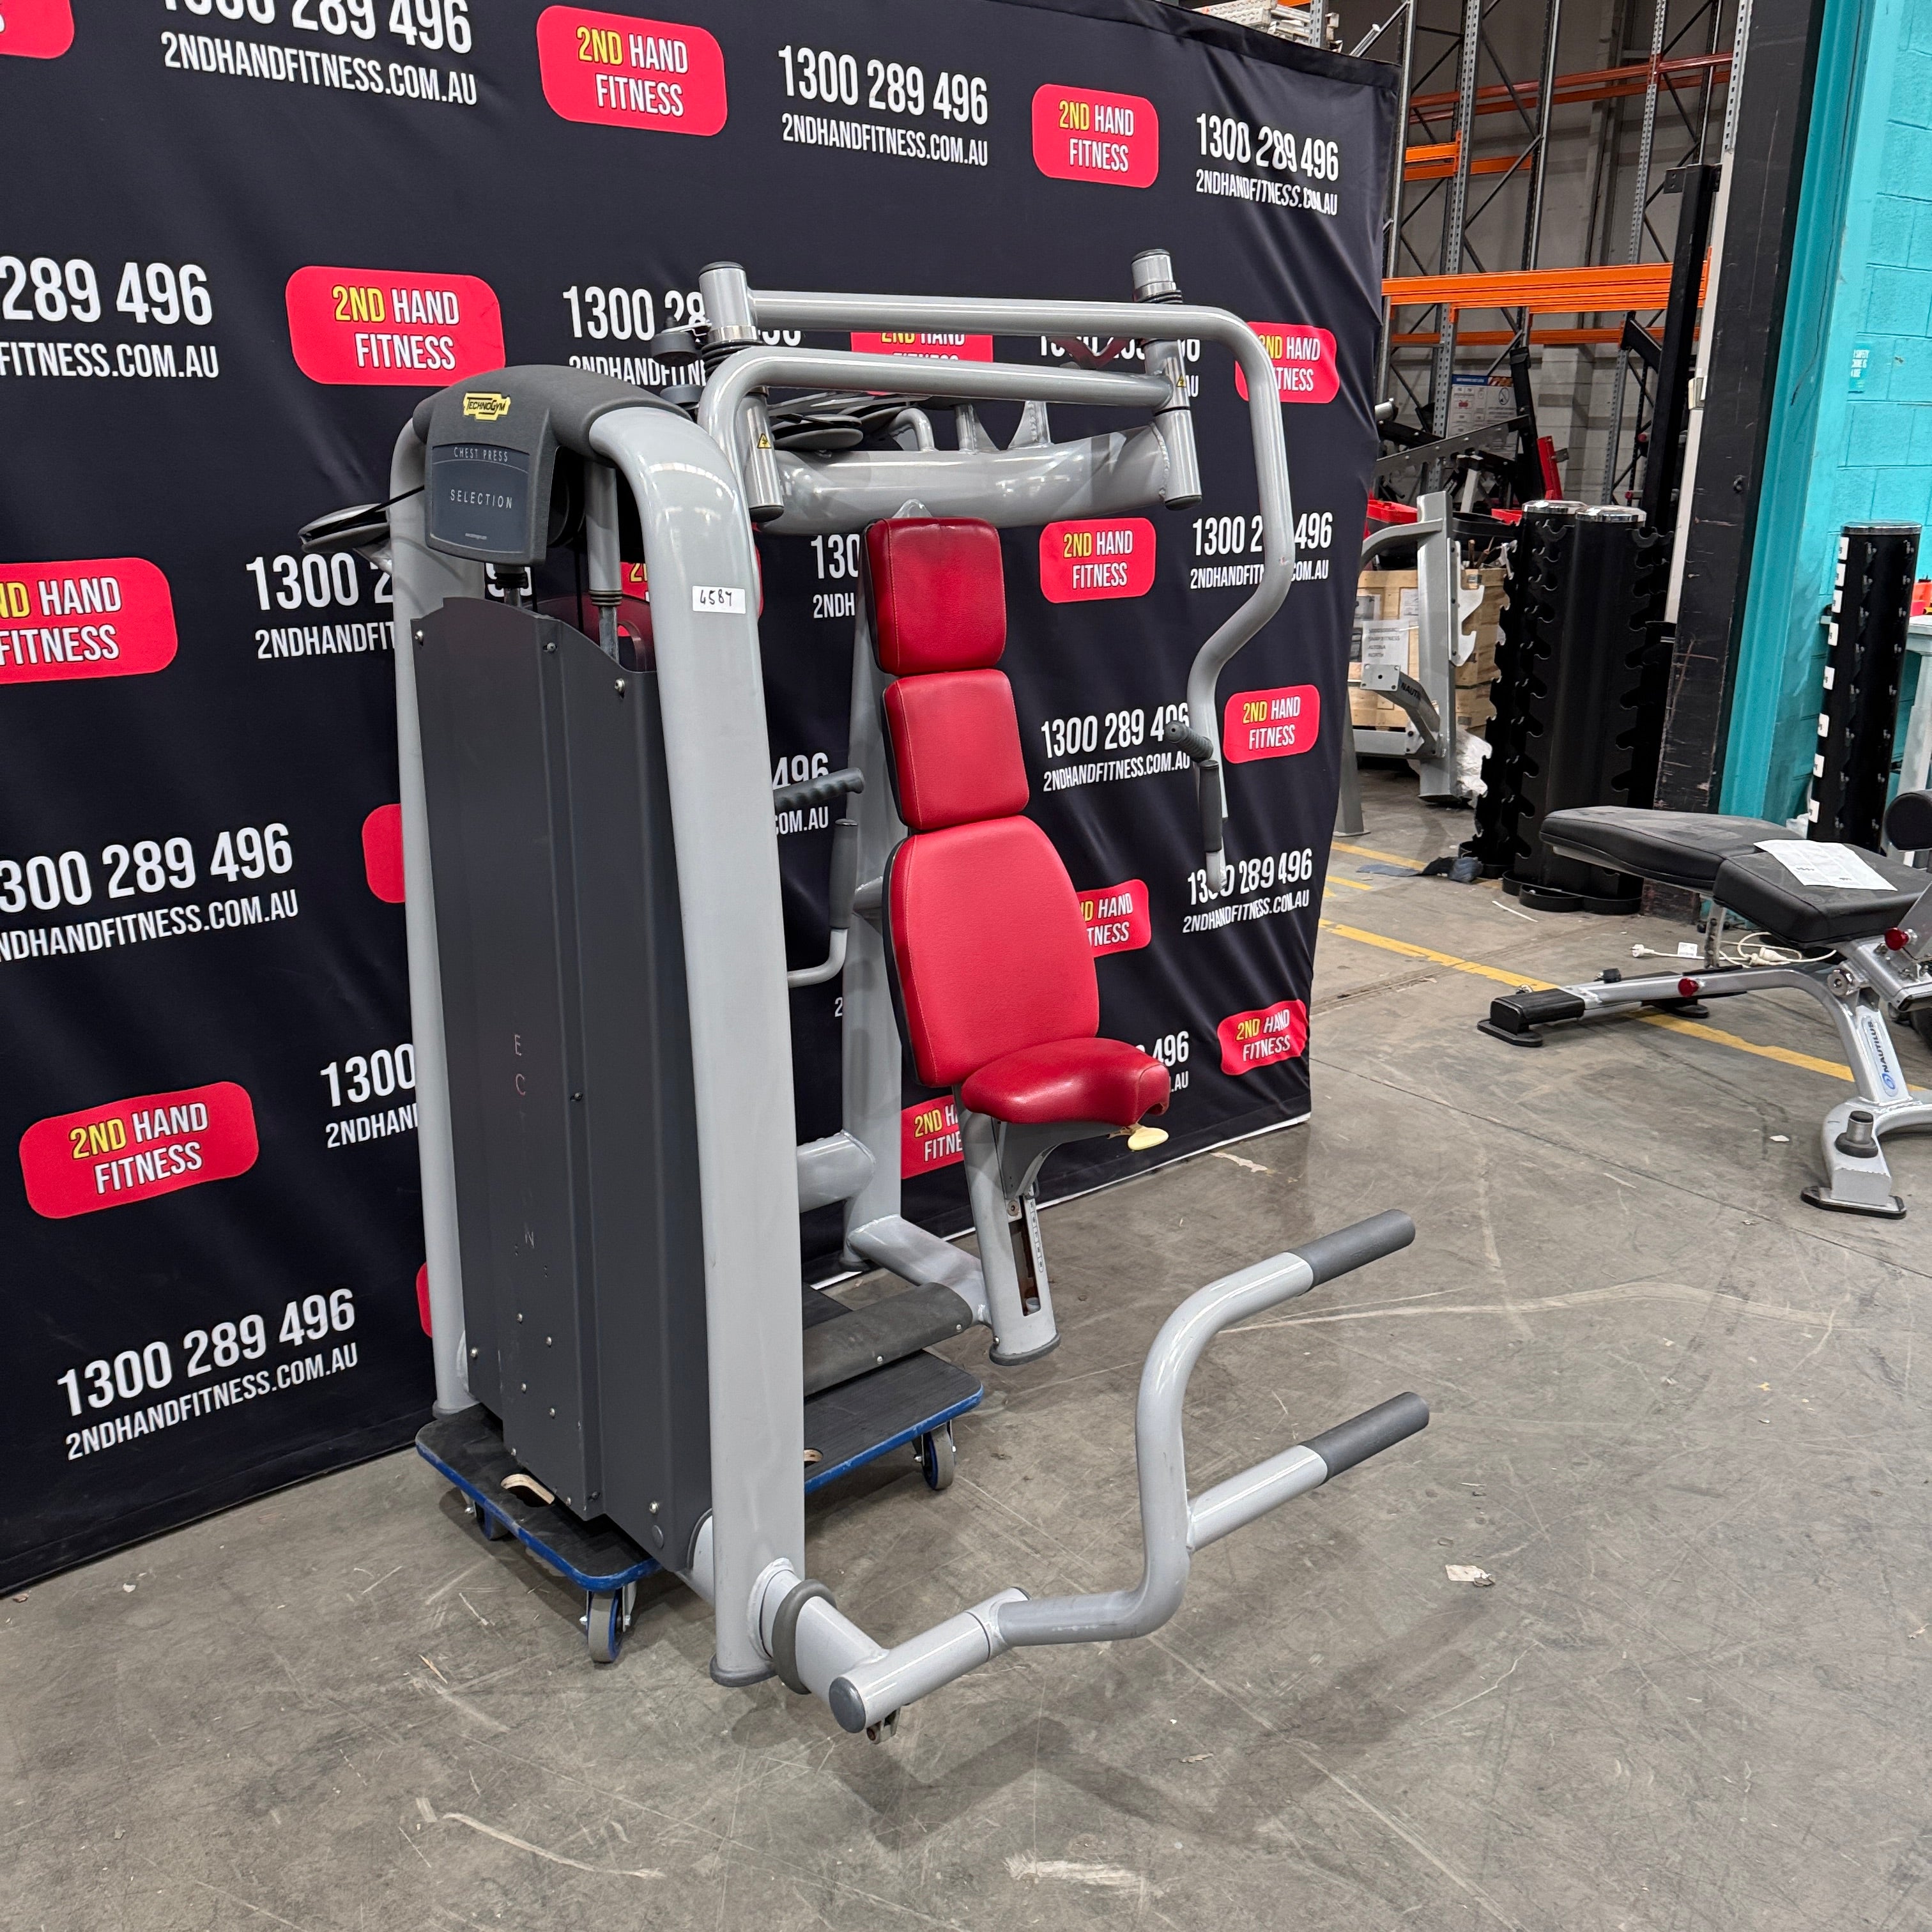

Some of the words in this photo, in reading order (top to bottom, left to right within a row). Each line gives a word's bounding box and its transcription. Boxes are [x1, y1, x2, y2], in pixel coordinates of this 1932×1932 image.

[388, 0, 473, 54] 496
[161, 31, 478, 105] 2NDHANDFITNESS.COM.AU
[577, 26, 623, 65] 2ND
[629, 34, 688, 73] HAND
[595, 73, 684, 117] FITNESS
[778, 45, 859, 105] 1300
[867, 59, 924, 116] 289
[933, 72, 988, 125] 496
[781, 112, 989, 167] 2NDHANDFITNESS.COM.AU
[1059, 100, 1090, 130] 2ND
[1094, 104, 1134, 136] HAND
[1070, 138, 1129, 172] FITNESS
[1196, 112, 1251, 164] 1300
[1255, 126, 1298, 172] 289
[1300, 137, 1338, 181] 496
[0, 256, 101, 323] 289
[116, 262, 213, 325] 496
[332, 286, 385, 322] 2ND
[391, 289, 459, 325] HAND
[562, 286, 655, 341] 1300
[355, 333, 456, 370] FITNESS
[1286, 336, 1321, 361] HAND
[1274, 366, 1315, 392] TNESS
[454, 447, 479, 459] CHEST
[483, 449, 509, 463] PRESS
[450, 489, 512, 509] SELECTION
[1064, 532, 1092, 558] 2ND
[1096, 530, 1133, 556] HAND
[1192, 516, 1245, 556] 1300
[1294, 511, 1334, 550] 496
[245, 552, 359, 611] 1300
[1073, 562, 1128, 589] FITNESS
[0, 580, 31, 620] D
[38, 577, 121, 616] HAND
[0, 624, 119, 666] FITNESS
[1243, 701, 1268, 724] 2ND
[1270, 696, 1301, 720] HAND
[1041, 715, 1098, 758] 1300
[1104, 709, 1144, 750] 289
[1249, 724, 1296, 750] FITNESS
[1043, 750, 1190, 792] 2NDHANDFITNESS.COM.AU
[775, 806, 829, 836] OM.AU
[0, 850, 92, 913] 300
[102, 838, 196, 899] 289
[210, 823, 293, 882] 496
[1187, 864, 1236, 905] 130
[1238, 856, 1275, 894] 289
[1278, 848, 1312, 884] 496
[1098, 893, 1133, 919] HAND
[1236, 1018, 1261, 1040] 2ND
[1263, 1009, 1290, 1033] HAND
[1152, 1030, 1190, 1067] 496
[1243, 1034, 1291, 1062] FITNESS
[1867, 1021, 1889, 1073] NAUTILUS
[319, 1043, 416, 1108] 1300
[70, 1119, 126, 1159] 2ND
[132, 1103, 208, 1143] HAND
[914, 1109, 942, 1137] 2ND
[945, 1104, 958, 1128] H
[95, 1142, 202, 1194] FITNESS
[56, 1340, 174, 1417] 1300
[183, 1314, 266, 1377] 289
[279, 1289, 355, 1346] 496
[65, 1342, 359, 1461] 2NDHANDFITNESS.COM.AU
